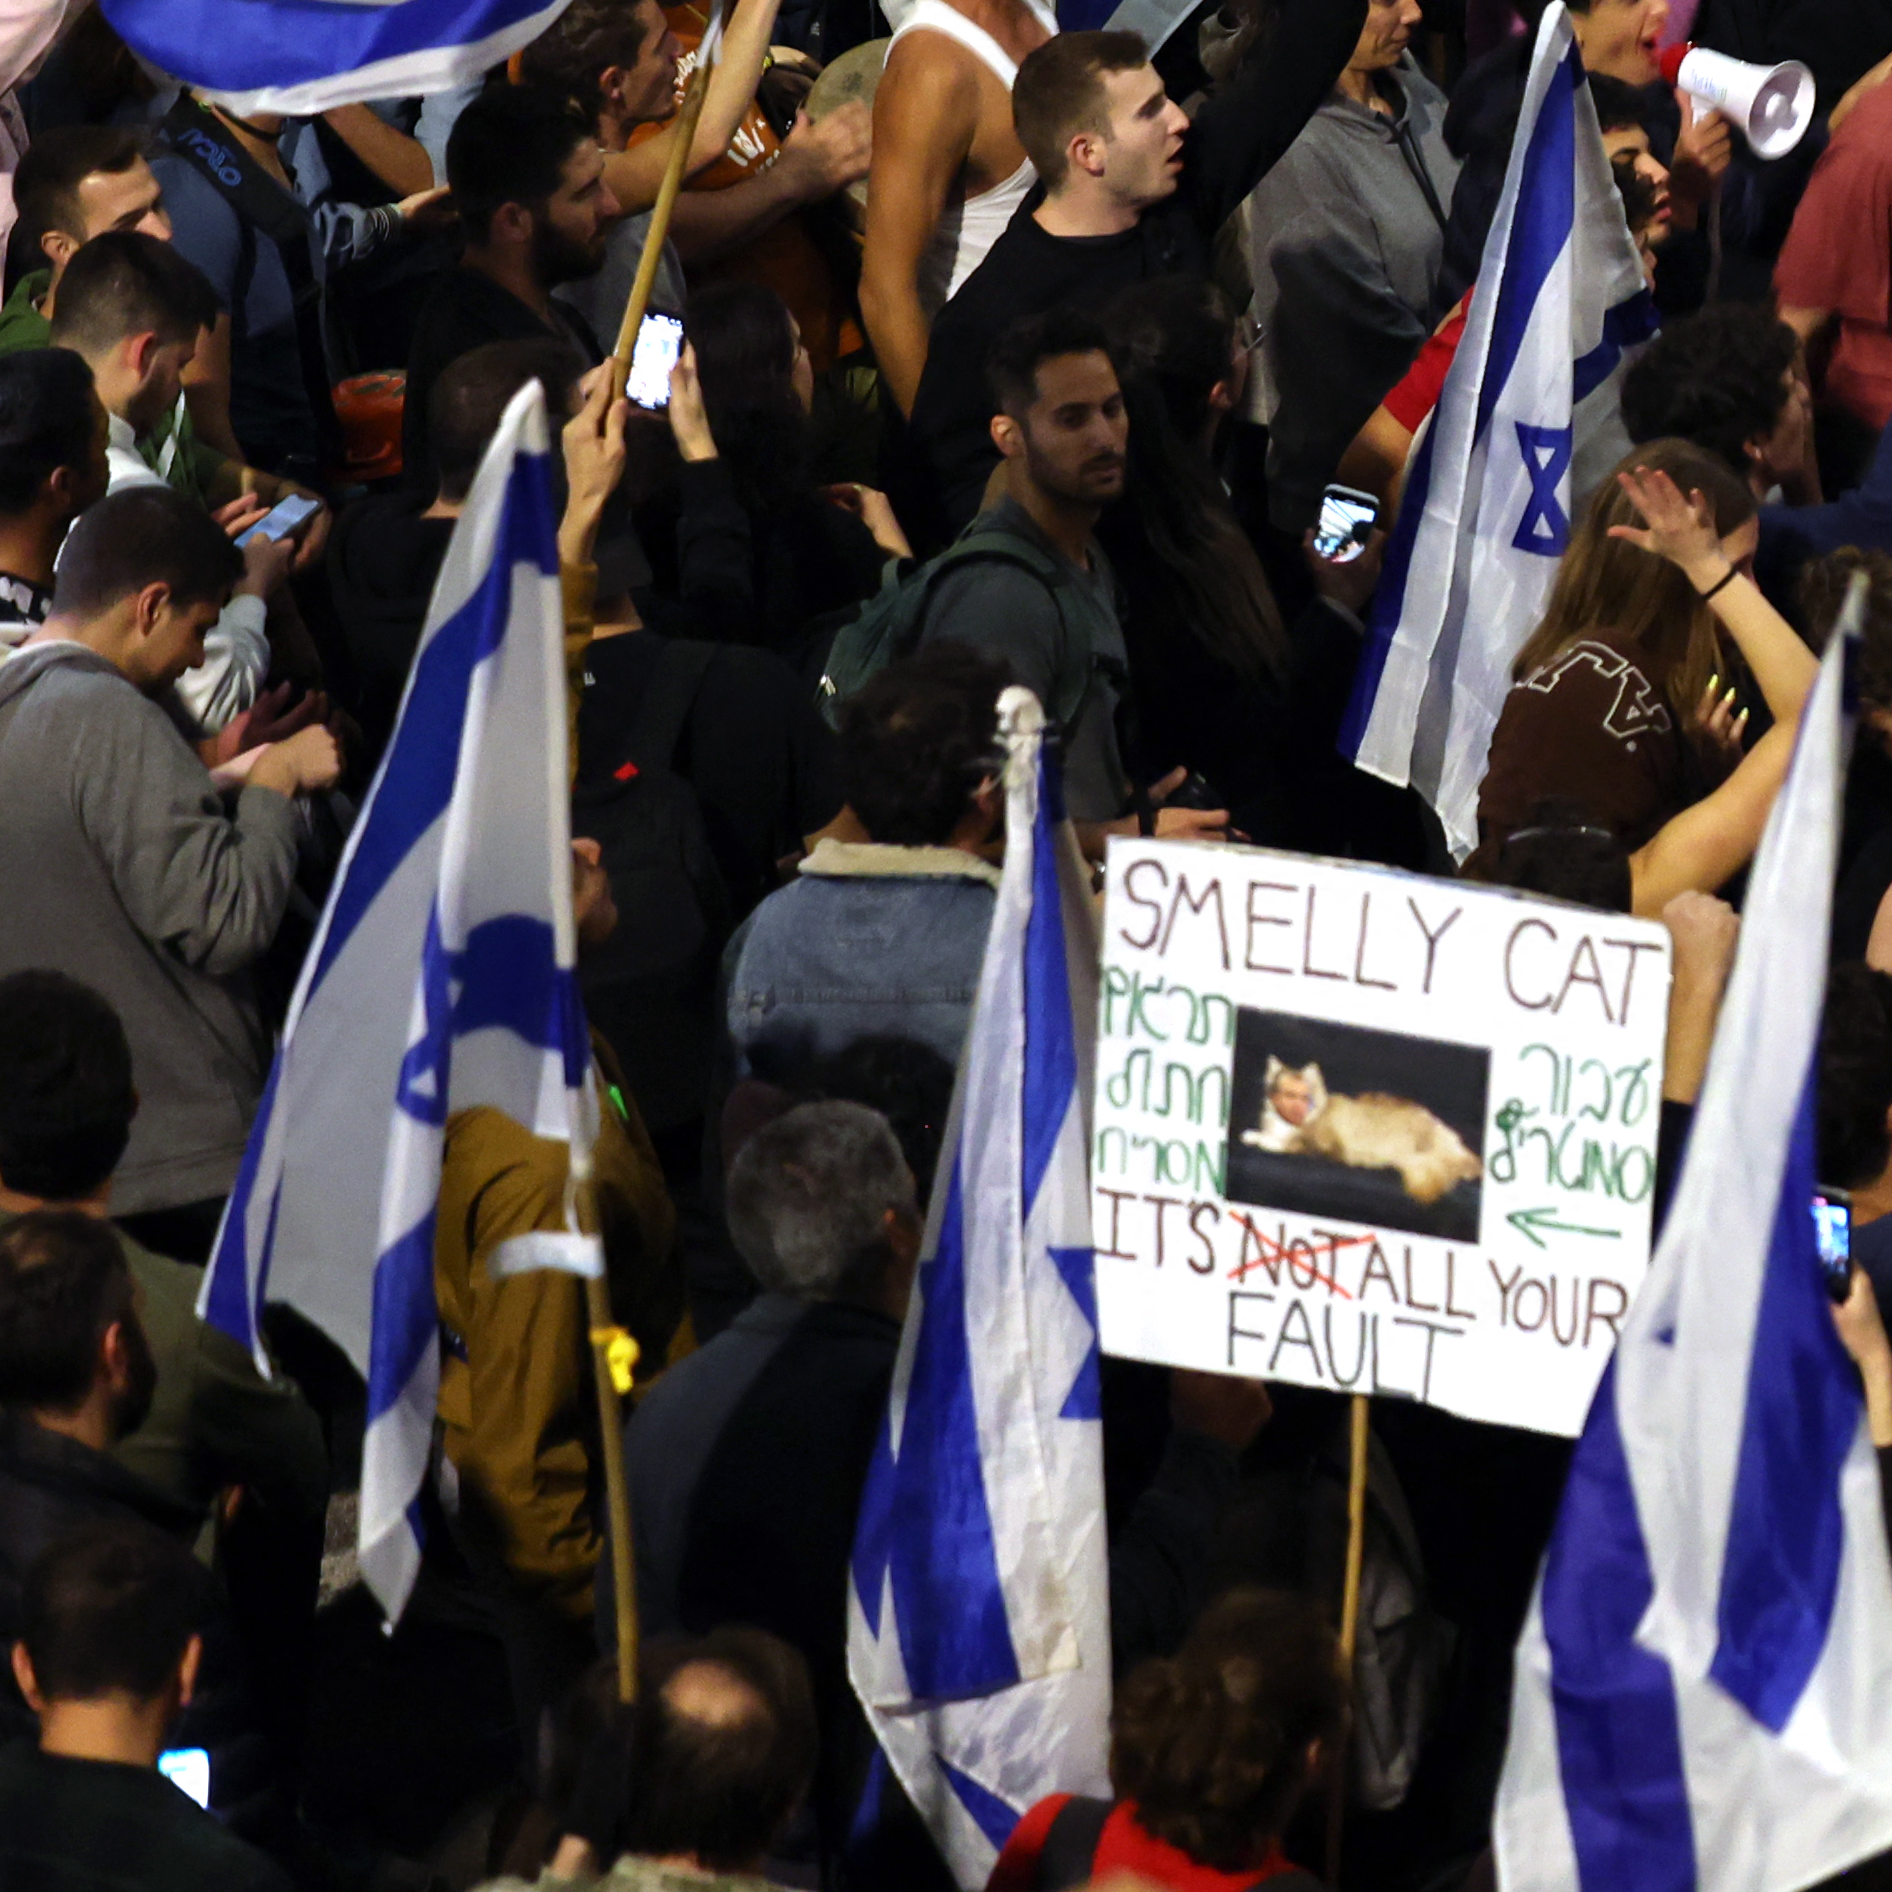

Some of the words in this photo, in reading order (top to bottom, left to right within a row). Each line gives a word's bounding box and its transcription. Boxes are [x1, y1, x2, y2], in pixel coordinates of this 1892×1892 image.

[1120, 858, 1463, 995] SMELLY
[1504, 917, 1664, 1027] CAT
[1107, 1048, 1229, 1128] חתול
[1518, 1041, 1653, 1128] עבור
[1099, 1125, 1228, 1196] מסריח
[1237, 1212, 1358, 1295] NOT
[1359, 1244, 1476, 1321] ALL
[1488, 1259, 1630, 1350] YOUR
[1226, 1291, 1466, 1403] FAULT
